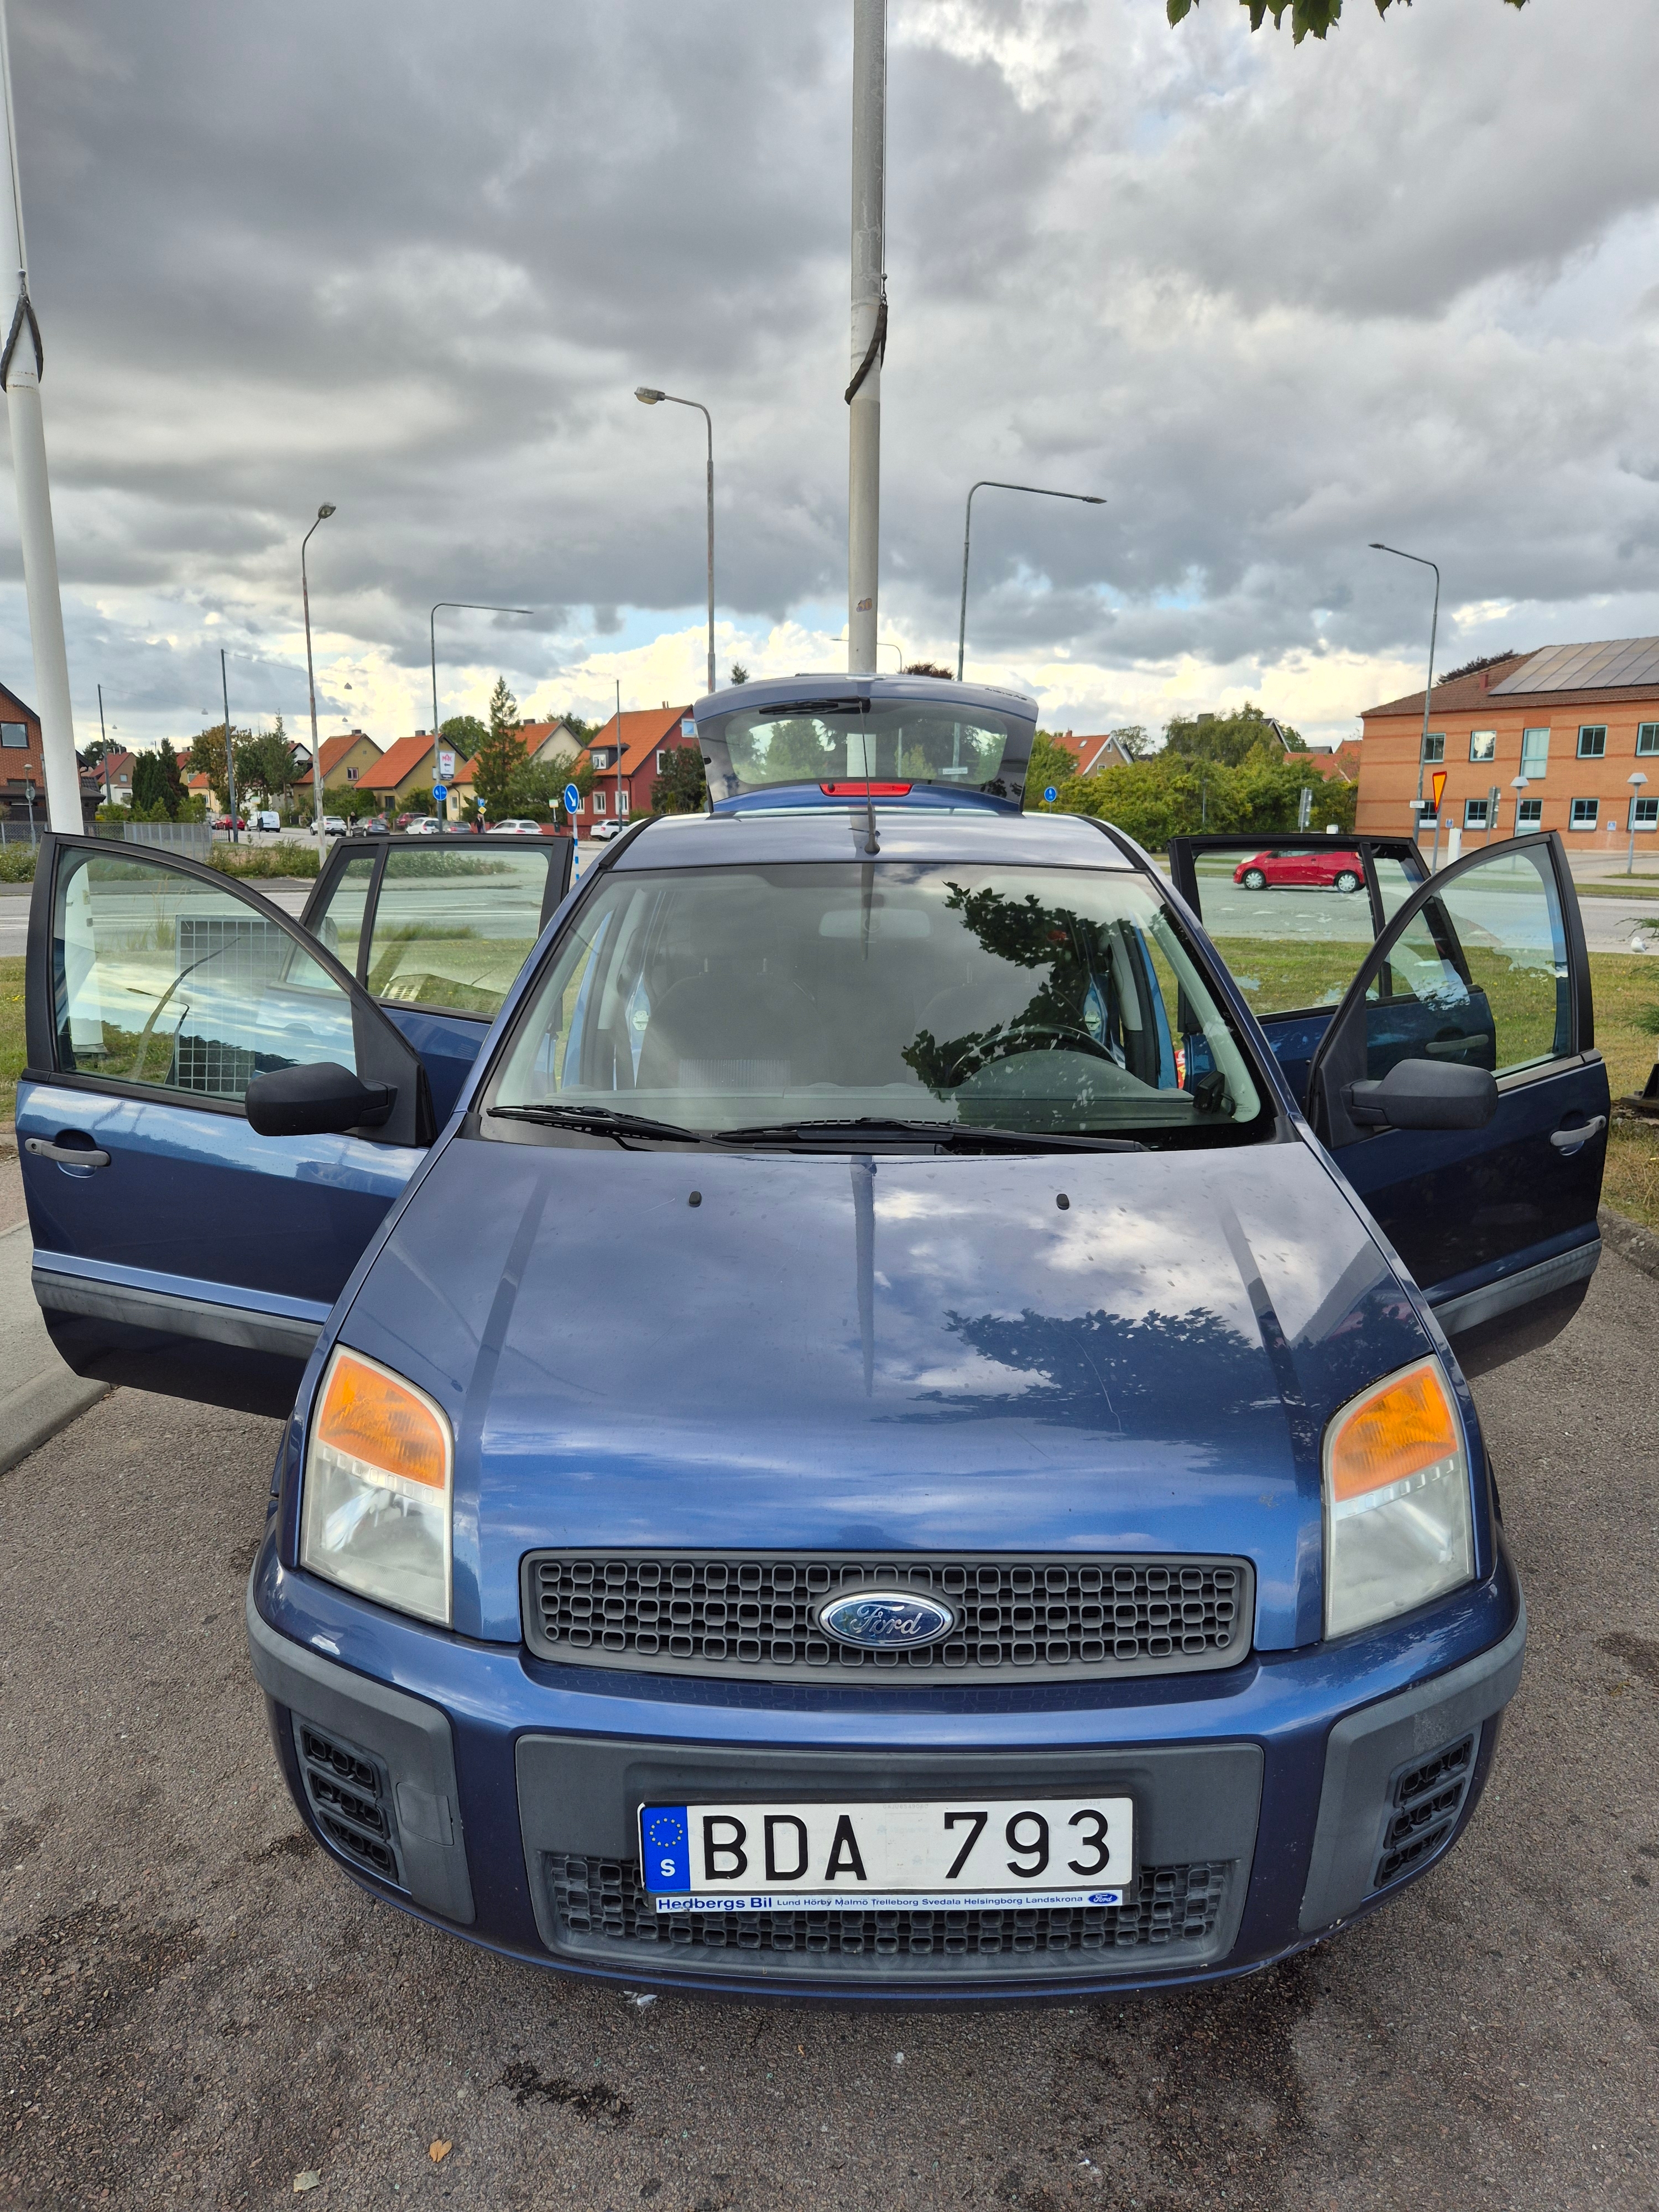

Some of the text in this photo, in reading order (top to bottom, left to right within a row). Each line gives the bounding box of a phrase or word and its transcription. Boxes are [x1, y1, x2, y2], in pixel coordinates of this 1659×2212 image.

[849, 1604, 922, 1634] Ford
[702, 1809, 1110, 1880] BDA 793
[660, 1859, 675, 1877] S
[658, 1897, 745, 1911] Hedbergs
[750, 1897, 772, 1908] Bil
[964, 1897, 1022, 1905] Helsingborg
[1093, 1894, 1113, 1902] Ford
